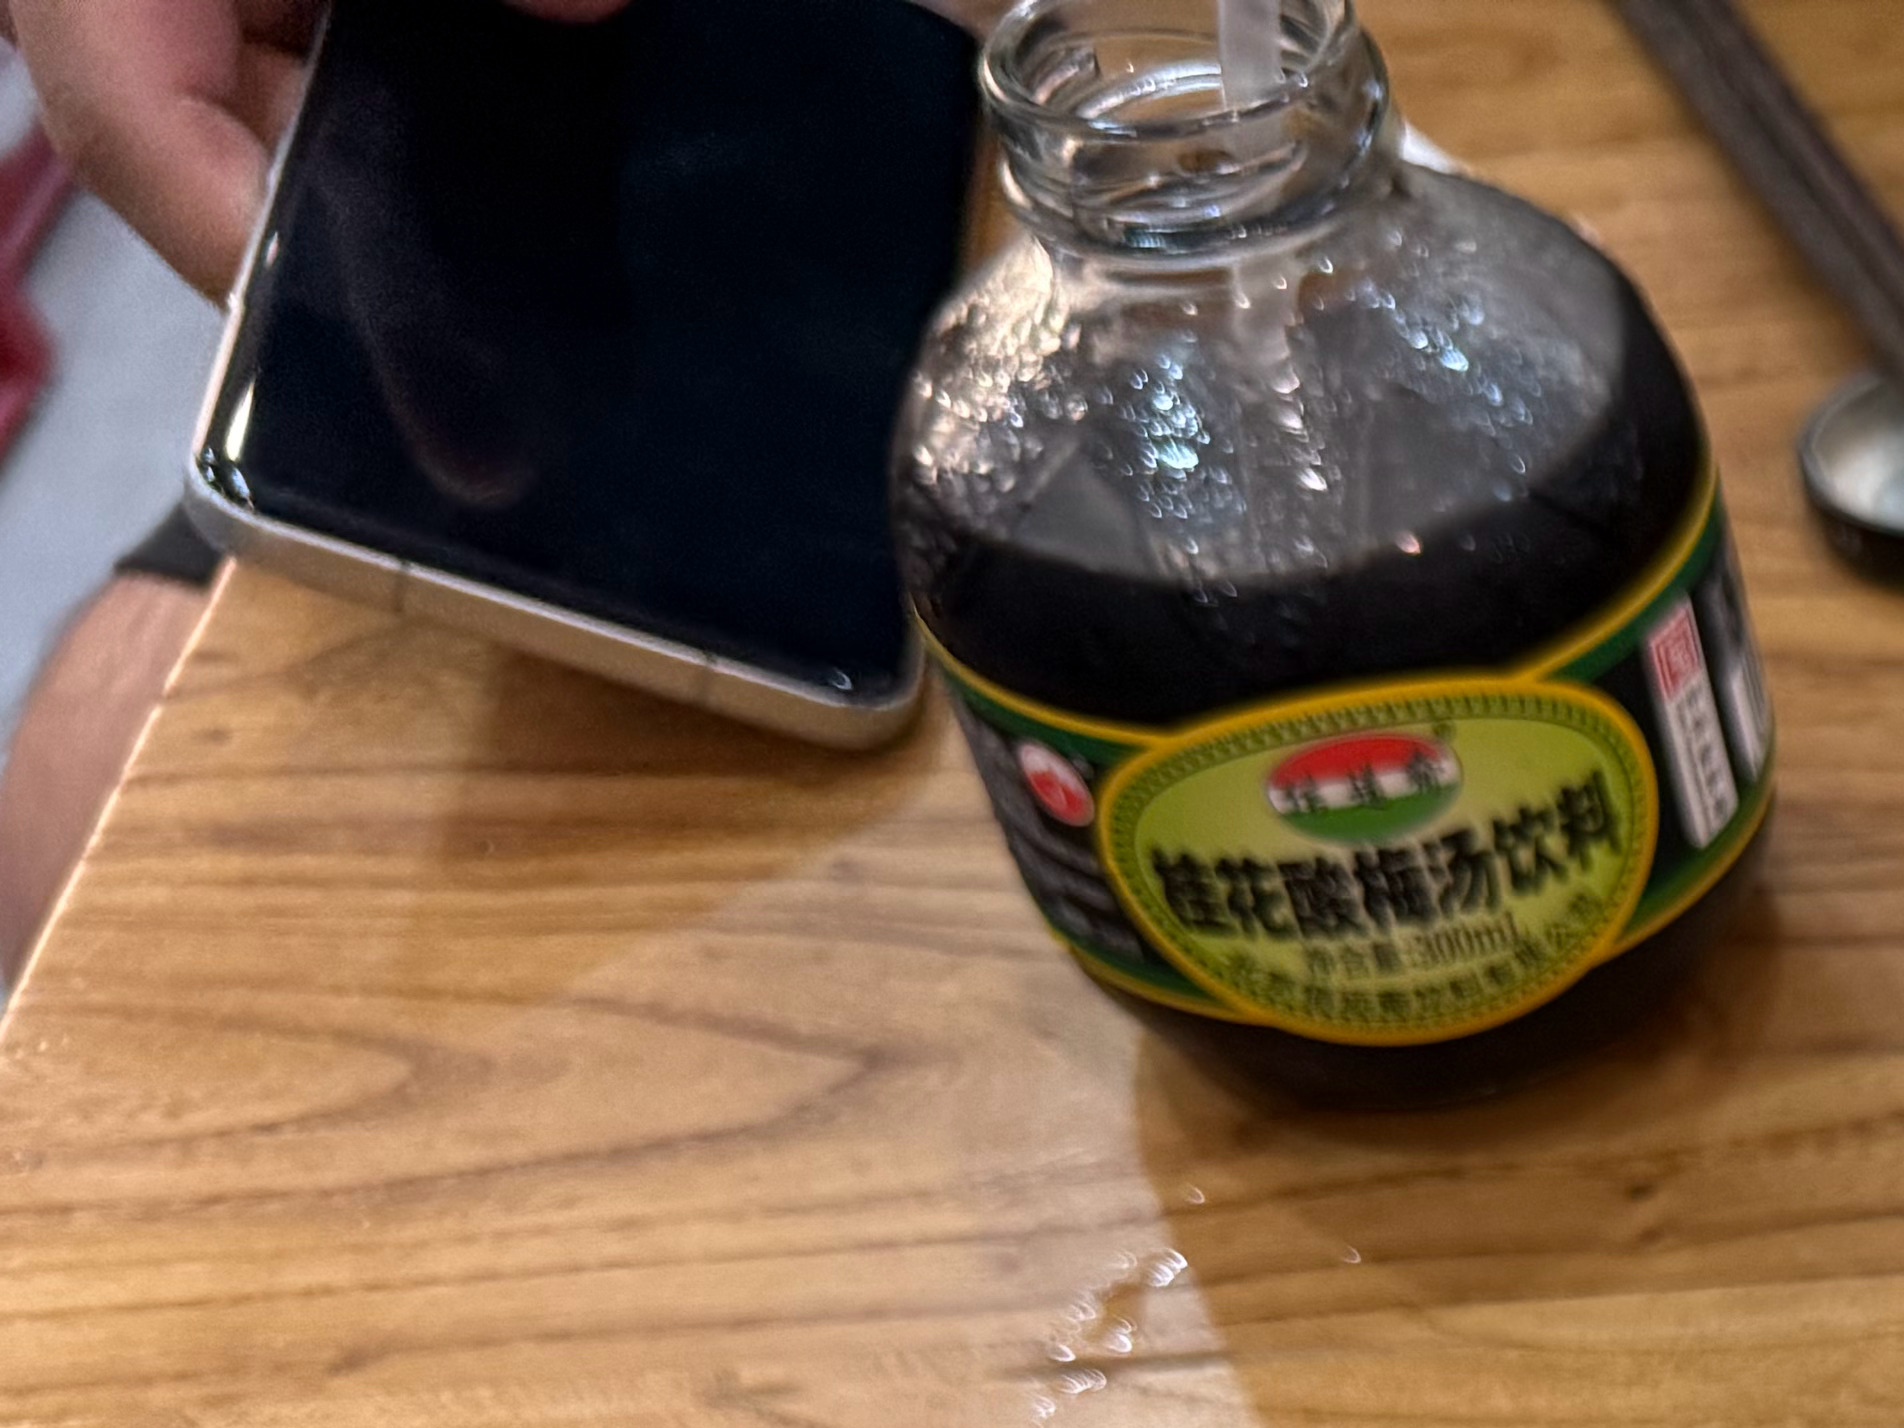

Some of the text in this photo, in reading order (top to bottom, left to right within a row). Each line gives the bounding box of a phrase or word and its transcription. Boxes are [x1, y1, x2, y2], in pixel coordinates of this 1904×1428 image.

[1150, 774, 1622, 940] 桂花酸梅汤饮料
